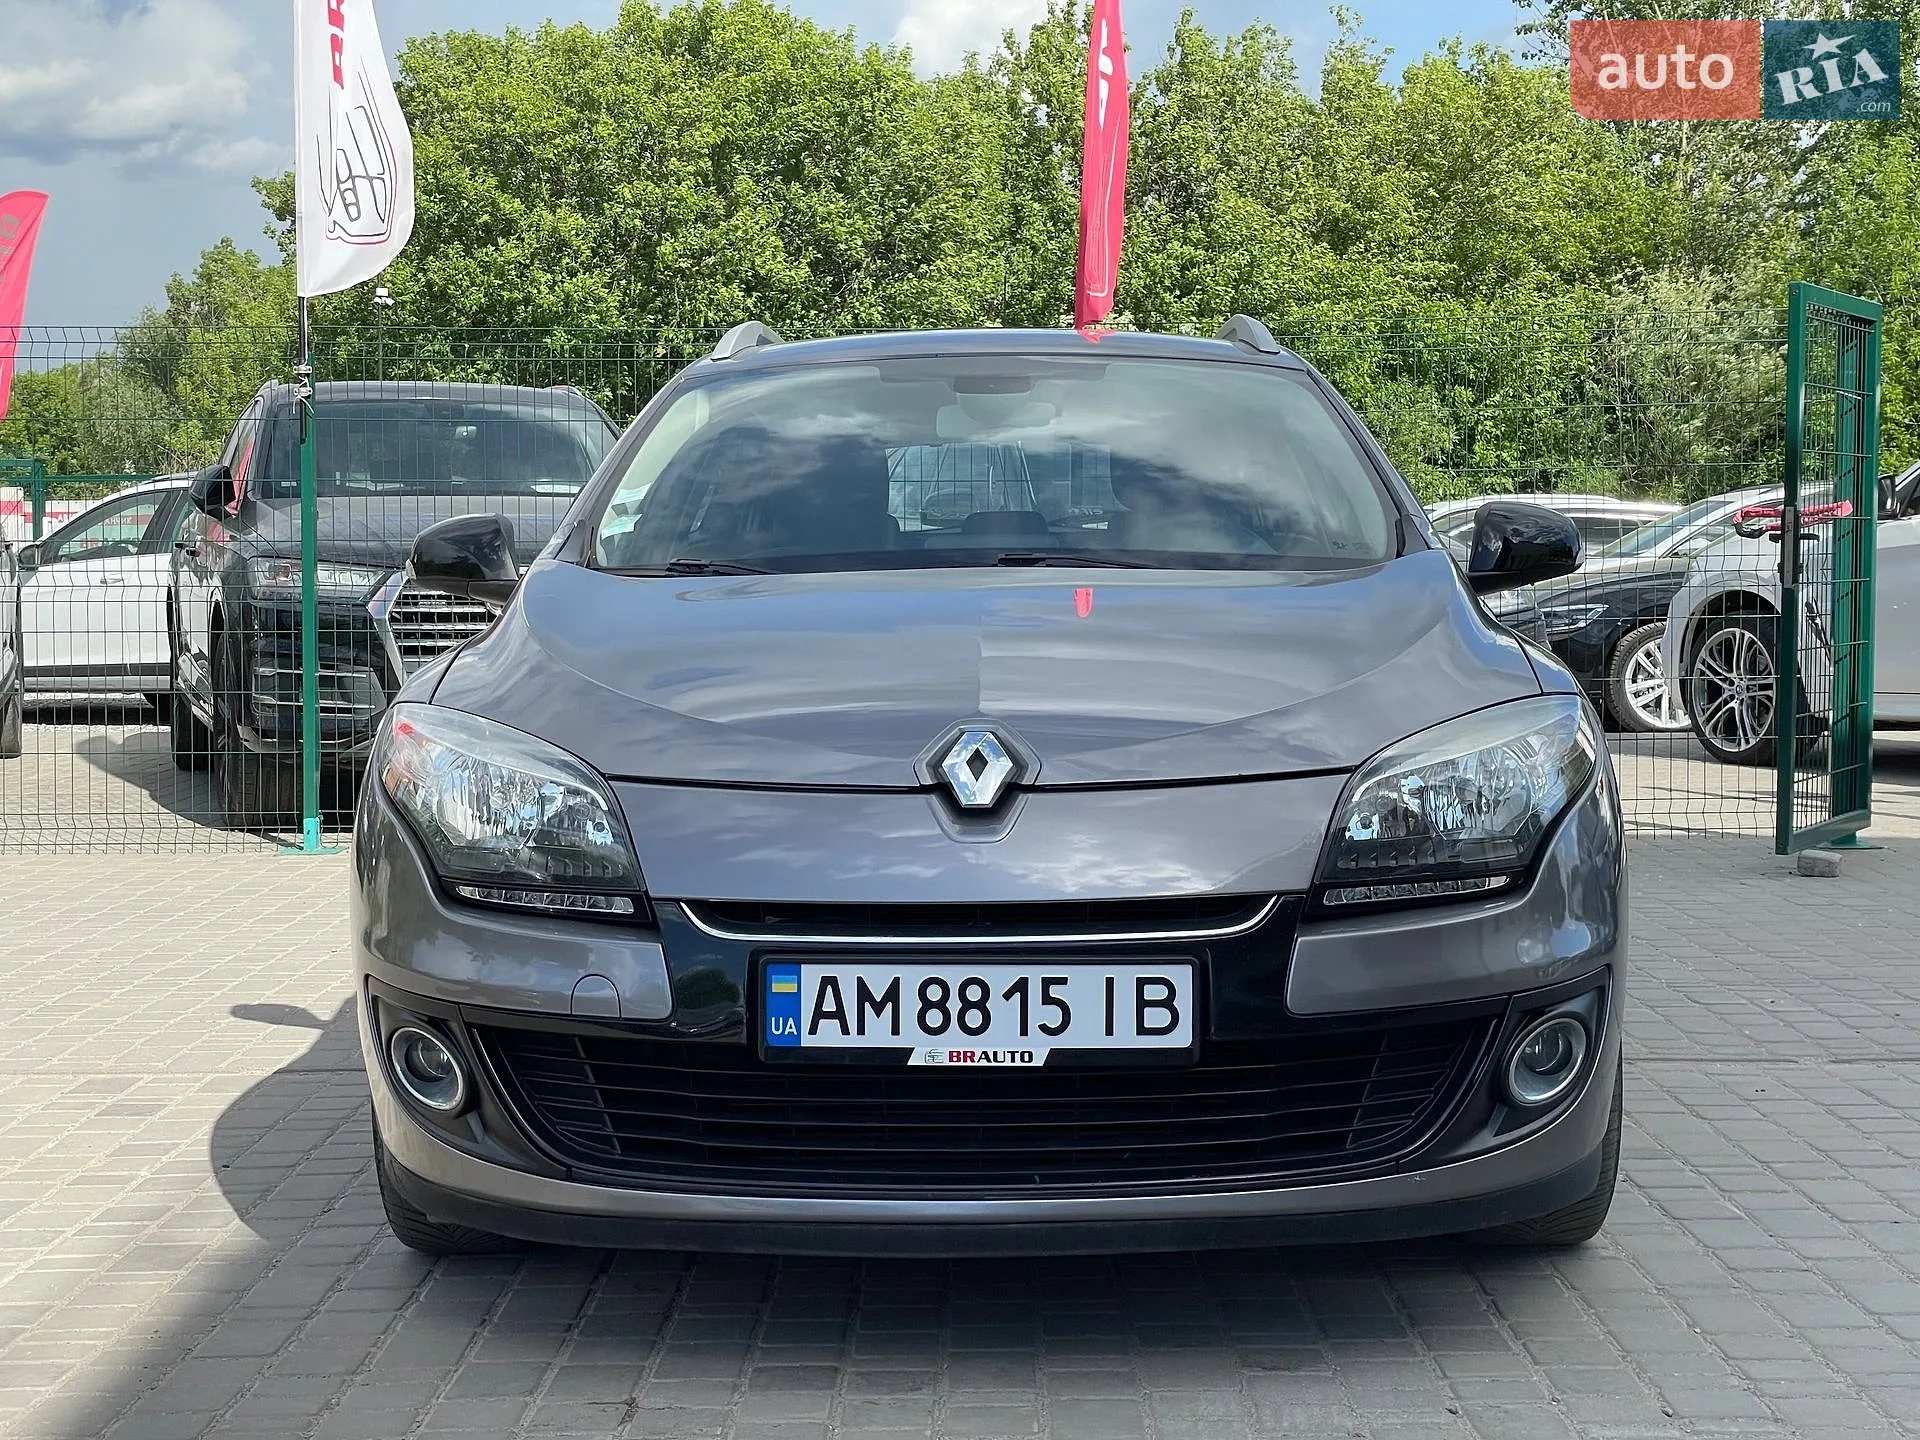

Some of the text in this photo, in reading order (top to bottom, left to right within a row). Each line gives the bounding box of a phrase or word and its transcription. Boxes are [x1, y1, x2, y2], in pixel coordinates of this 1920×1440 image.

[807, 975, 1180, 1038] AM 8815 IB
[771, 1016, 798, 1036] UA
[948, 1050, 1034, 1063] BRAUTO
